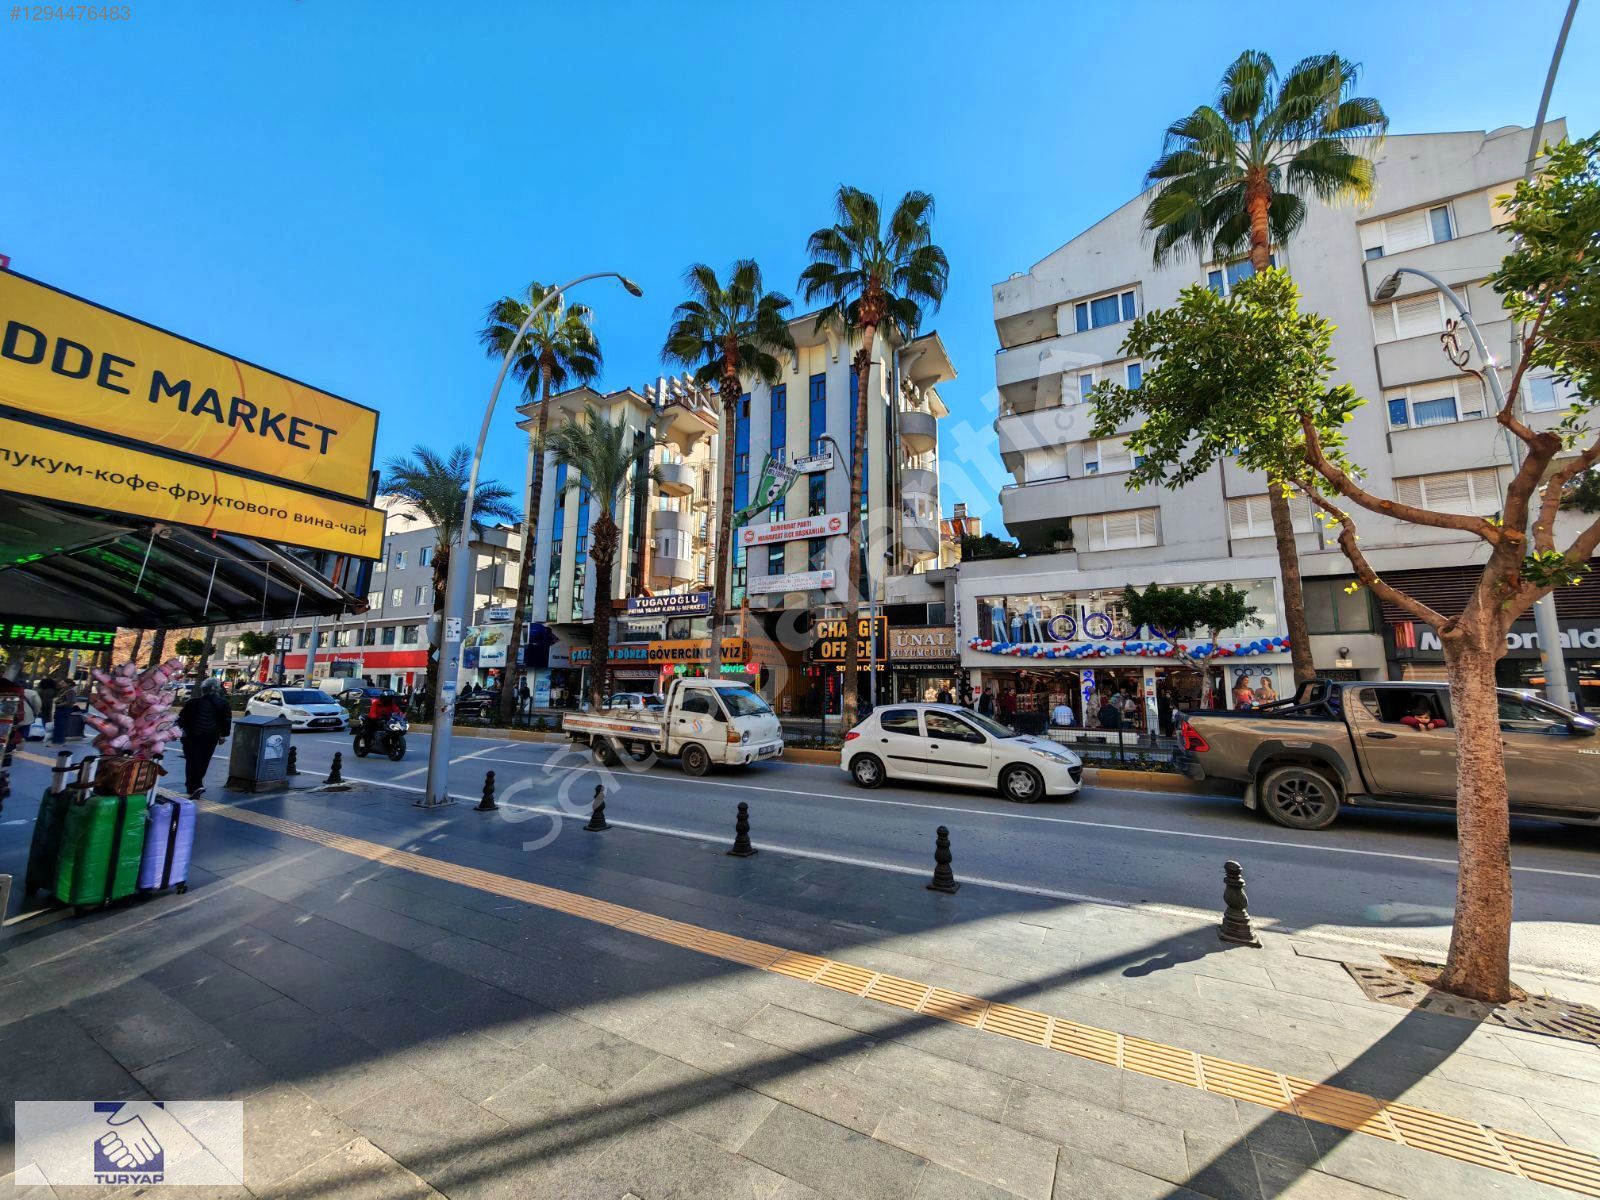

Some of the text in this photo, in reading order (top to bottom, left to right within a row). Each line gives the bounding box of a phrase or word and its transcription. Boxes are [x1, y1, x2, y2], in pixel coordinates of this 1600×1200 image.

[1, 320, 339, 456] DDE MARKET
[293, 512, 367, 538] вина-чай
[635, 594, 699, 607] TUGAYOĞLU
[10, 624, 118, 645] MARKET
[817, 620, 879, 638] CHAGE
[896, 630, 949, 647] ÜNAL
[1420, 628, 1600, 650] Monld
[617, 647, 648, 659] DÖNER
[821, 640, 871, 658] OFFCE
[891, 648, 957, 657] KUYUMCULUK
